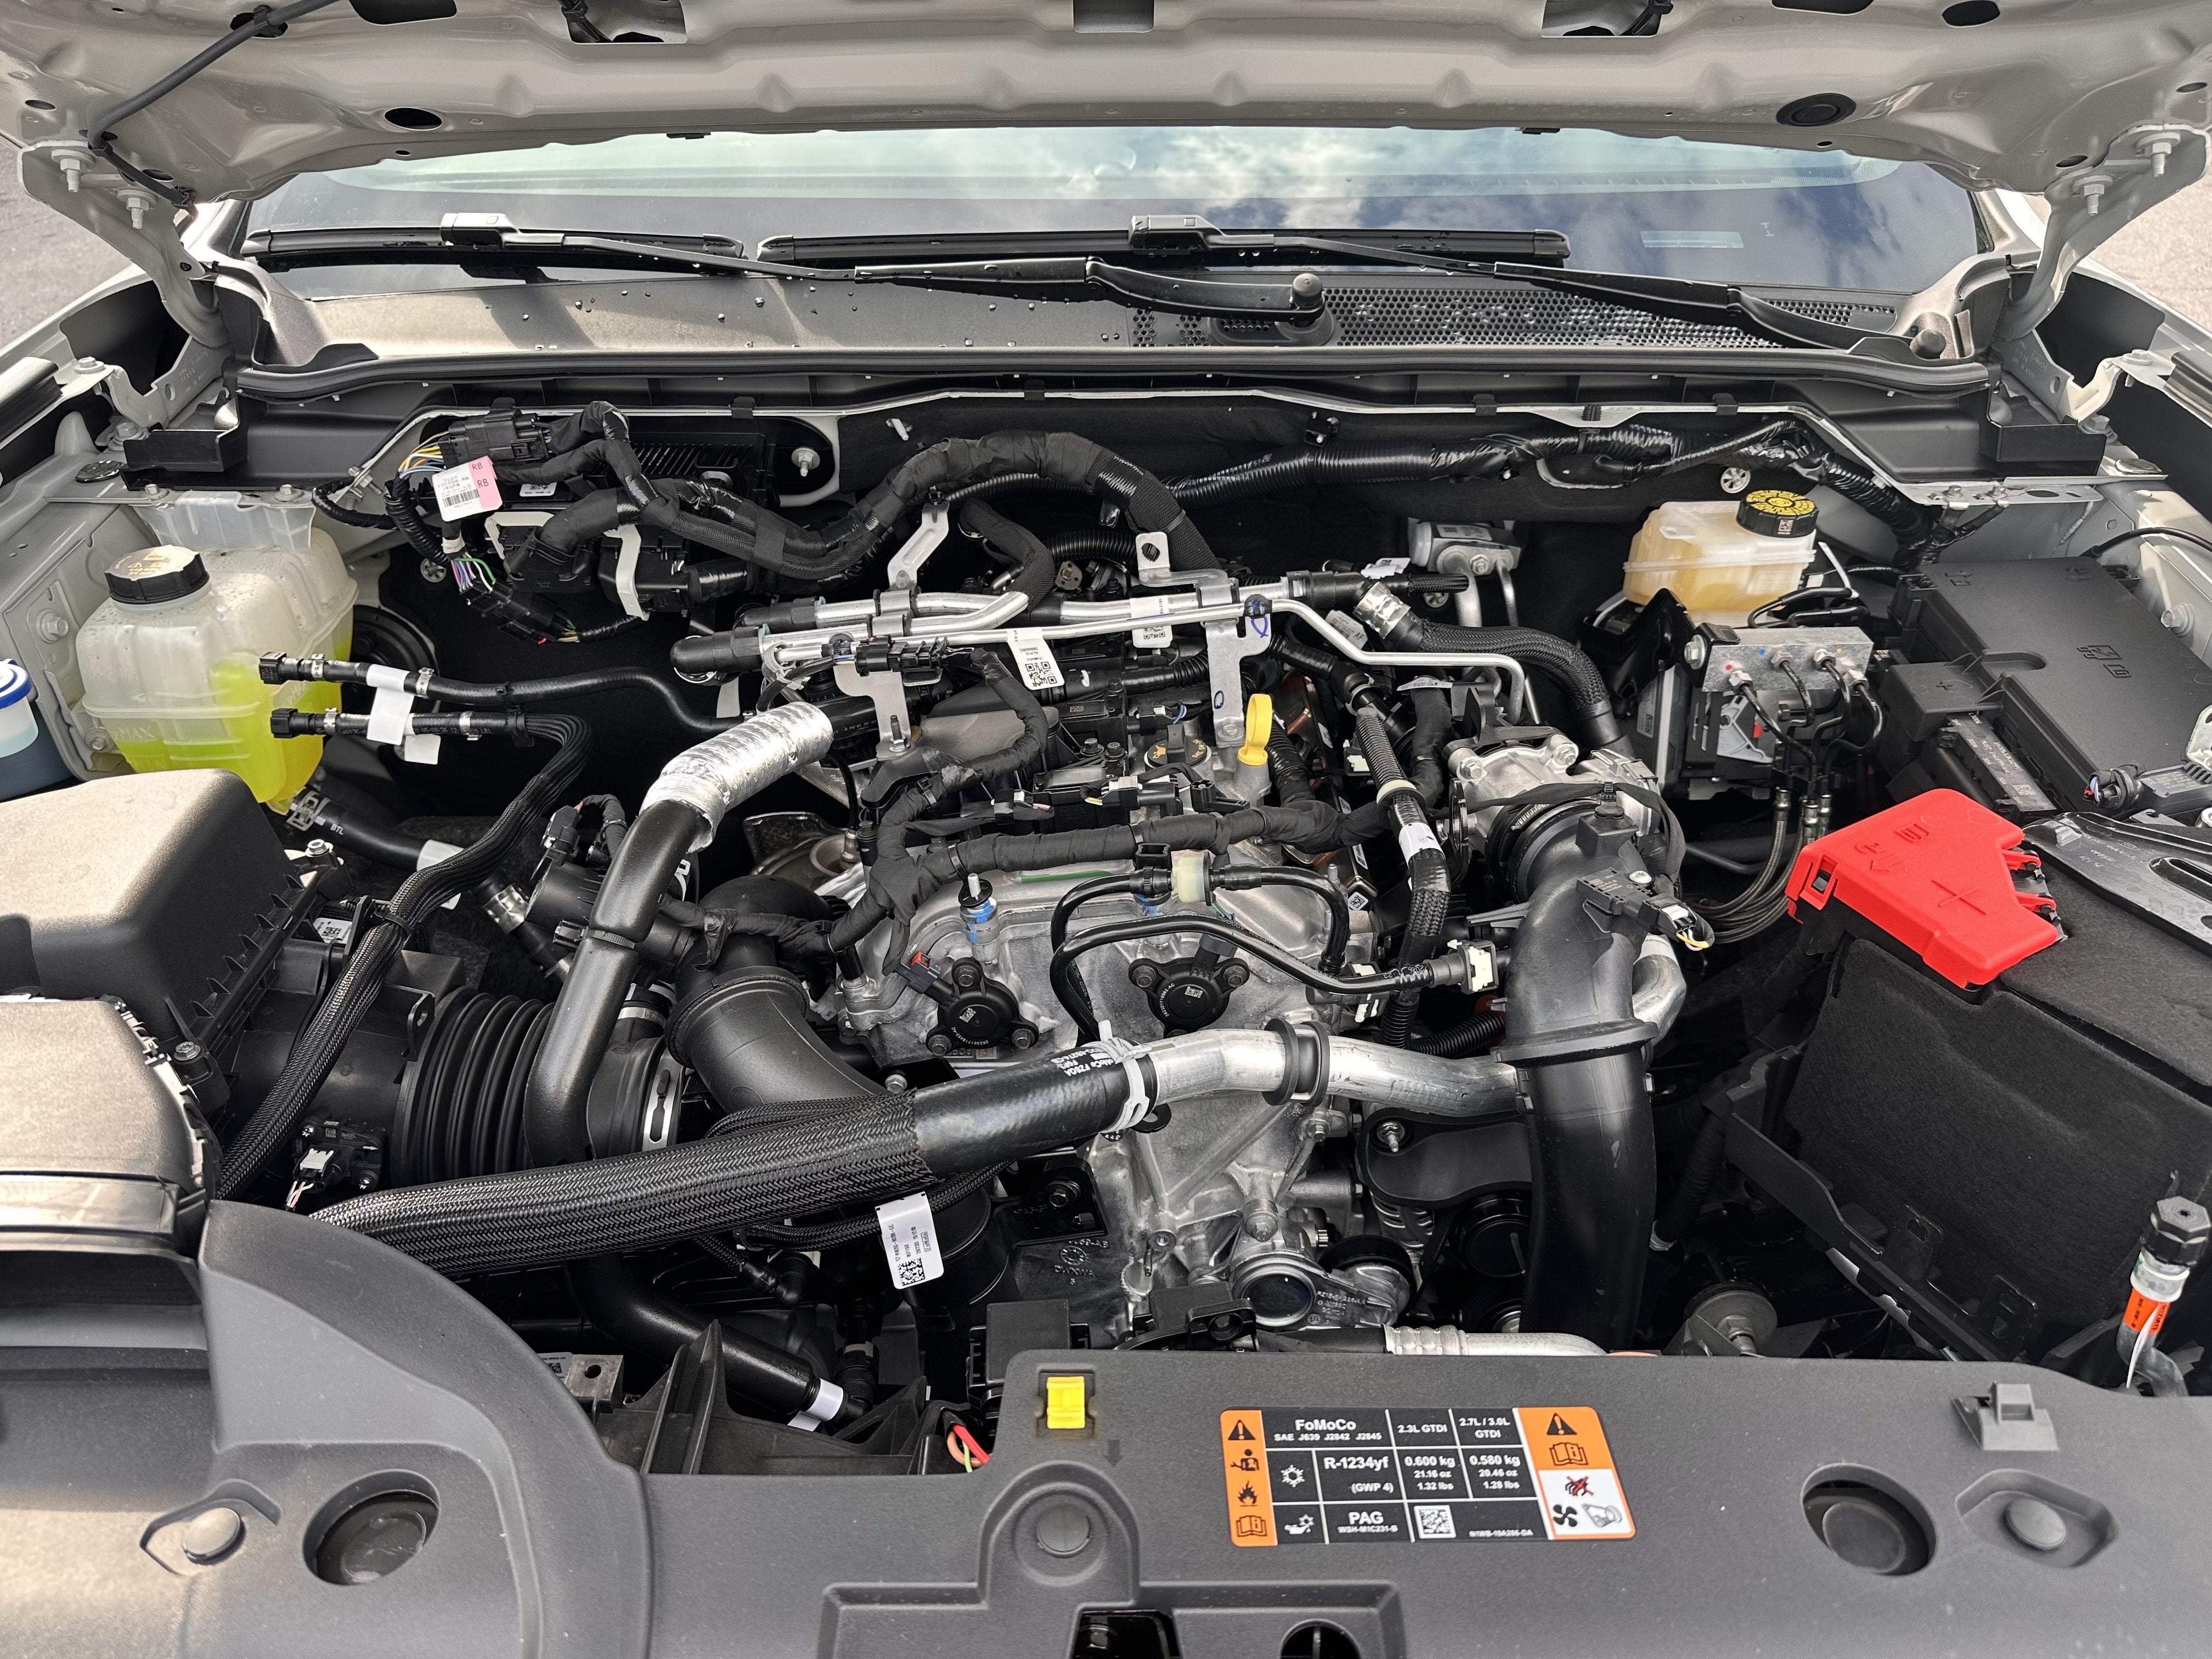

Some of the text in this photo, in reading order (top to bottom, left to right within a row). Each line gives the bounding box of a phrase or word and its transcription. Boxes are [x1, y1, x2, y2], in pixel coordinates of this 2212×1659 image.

[472, 462, 483, 471] RB
[477, 478, 489, 488] RB
[330, 823, 344, 835] BTL
[1295, 1419, 1357, 1431] FoMoCo
[1459, 1417, 1510, 1426] 2.7L / 3.0L
[1397, 1424, 1447, 1433] 2.3L GTDI
[1324, 1432, 1351, 1441] J2842
[1355, 1432, 1383, 1441] J2845
[1475, 1430, 1502, 1438] GTDI
[1323, 1456, 1389, 1471] R-1234yf
[1404, 1455, 1455, 1468] 0.600 kg
[1469, 1454, 1521, 1467] 0.580 kg
[1413, 1470, 1438, 1479] 21.16
[1478, 1469, 1504, 1477] 20.46
[1351, 1482, 1394, 1493] (GWP 4)
[1417, 1482, 1454, 1491] 1.32 lbs
[1483, 1480, 1520, 1489] 1.28 lbs
[1348, 1511, 1384, 1525] PAG
